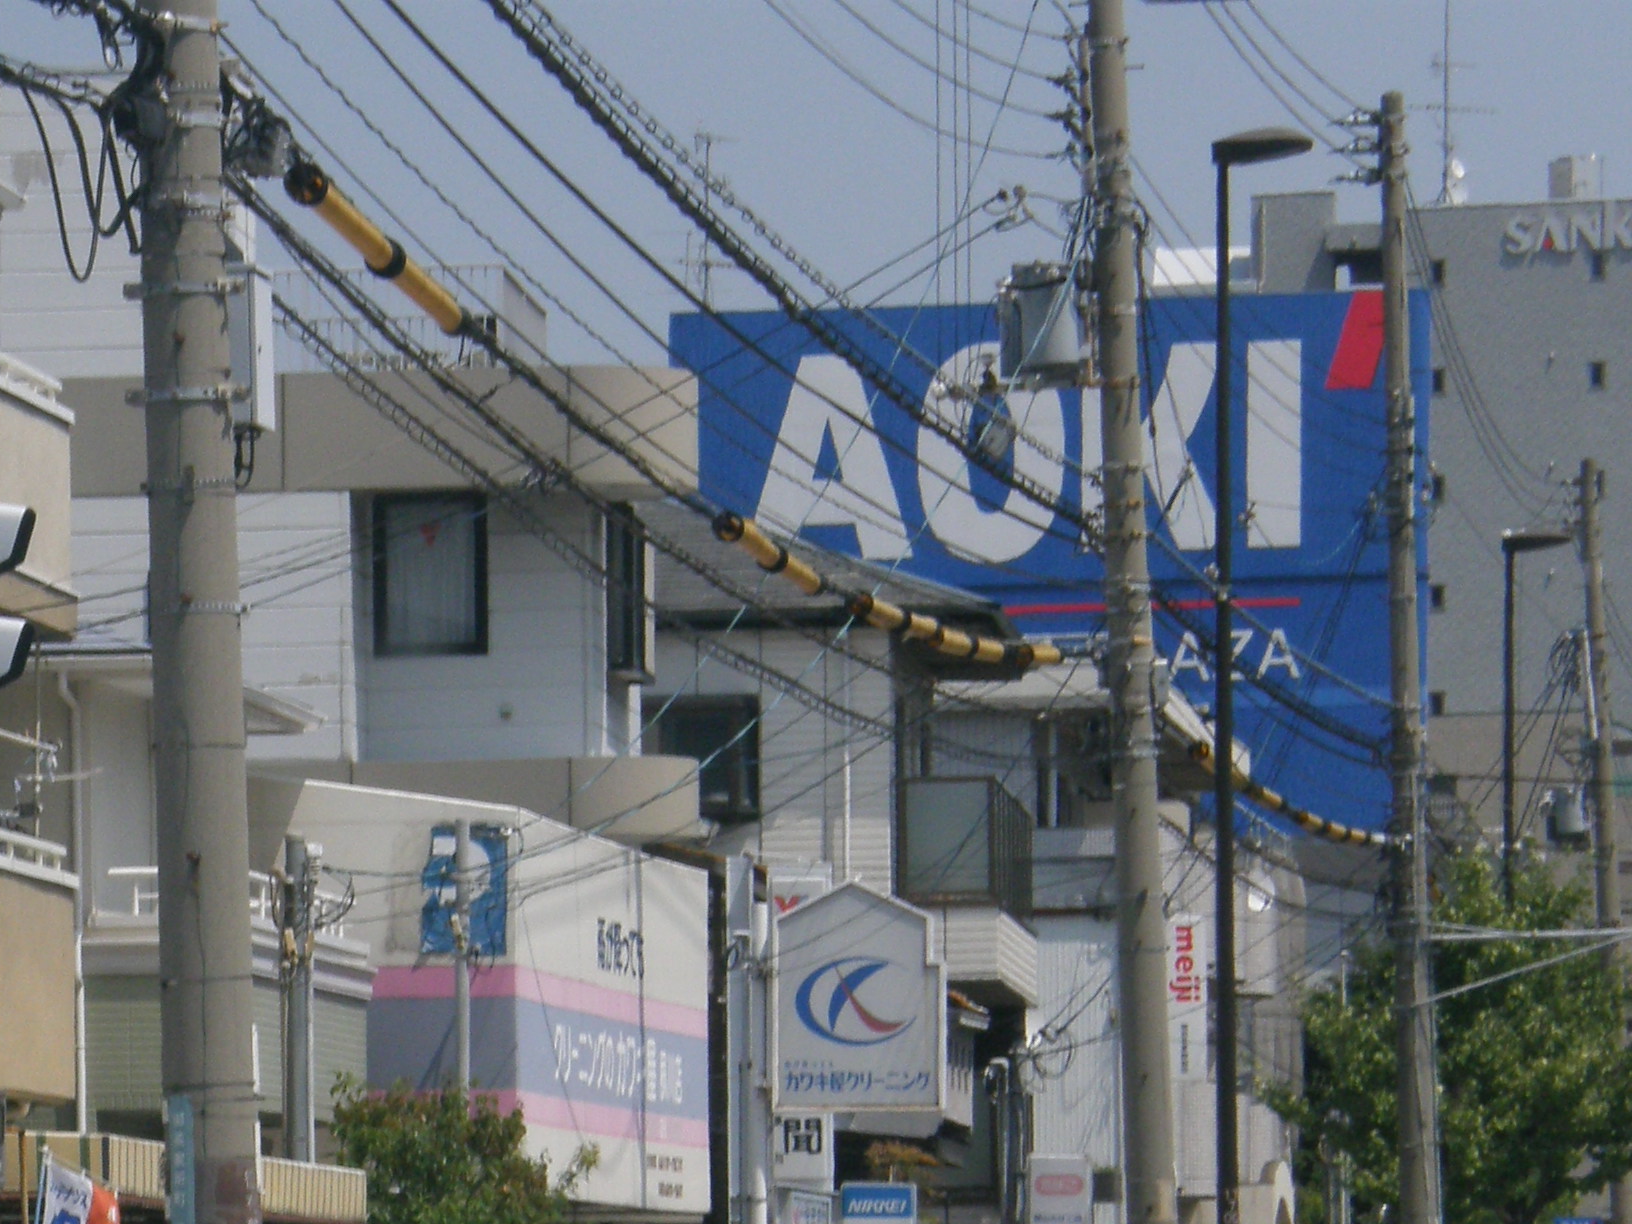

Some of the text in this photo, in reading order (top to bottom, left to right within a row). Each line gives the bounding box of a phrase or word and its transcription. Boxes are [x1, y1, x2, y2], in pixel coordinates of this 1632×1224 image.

[754, 339, 1303, 565] AOKI
[1169, 926, 1201, 1003] meiji
[847, 1198, 908, 1214] NIKKEI
